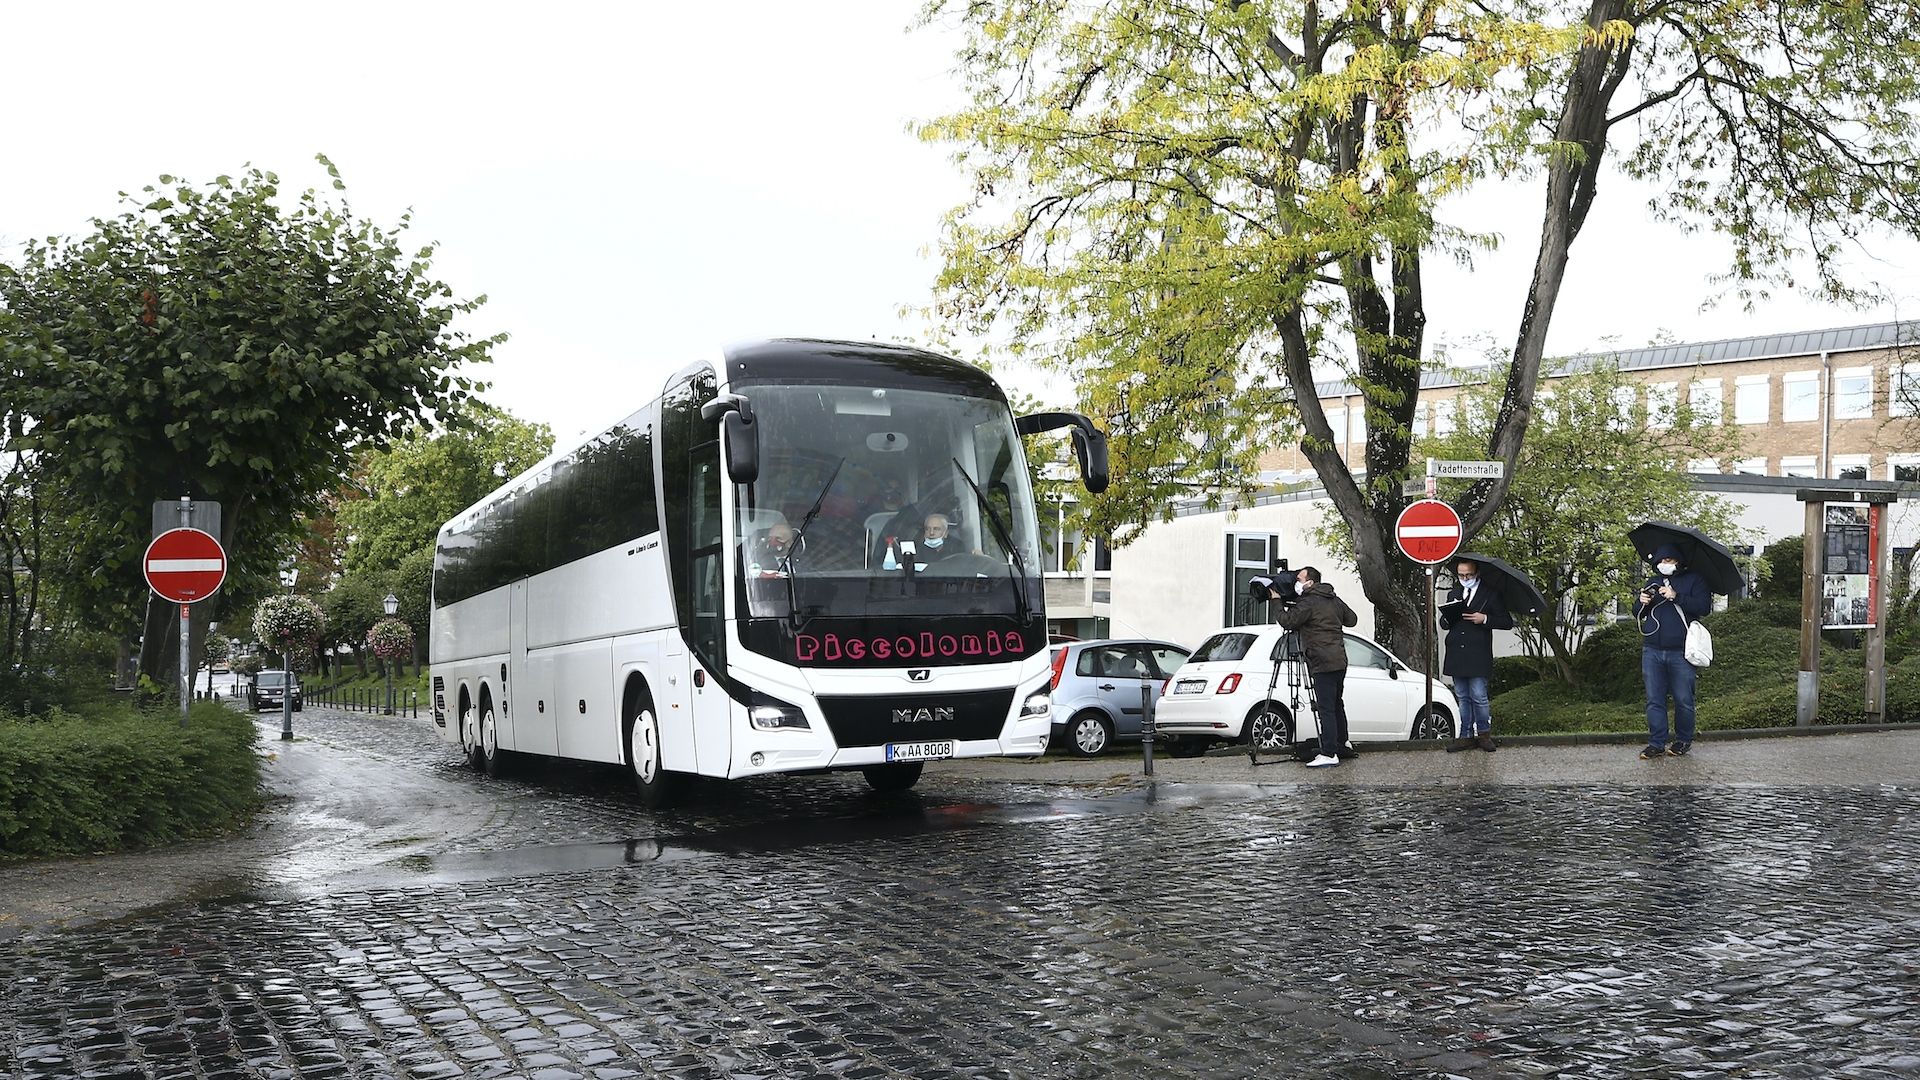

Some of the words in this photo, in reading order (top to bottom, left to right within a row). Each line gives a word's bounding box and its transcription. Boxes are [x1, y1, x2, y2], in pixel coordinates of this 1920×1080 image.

[1437, 464, 1499, 475] Kadettenstraße
[795, 630, 1025, 661] Piccolonia
[892, 706, 954, 723] MAN
[893, 745, 901, 758] K
[908, 744, 922, 757] AA
[923, 743, 951, 756] 8008
